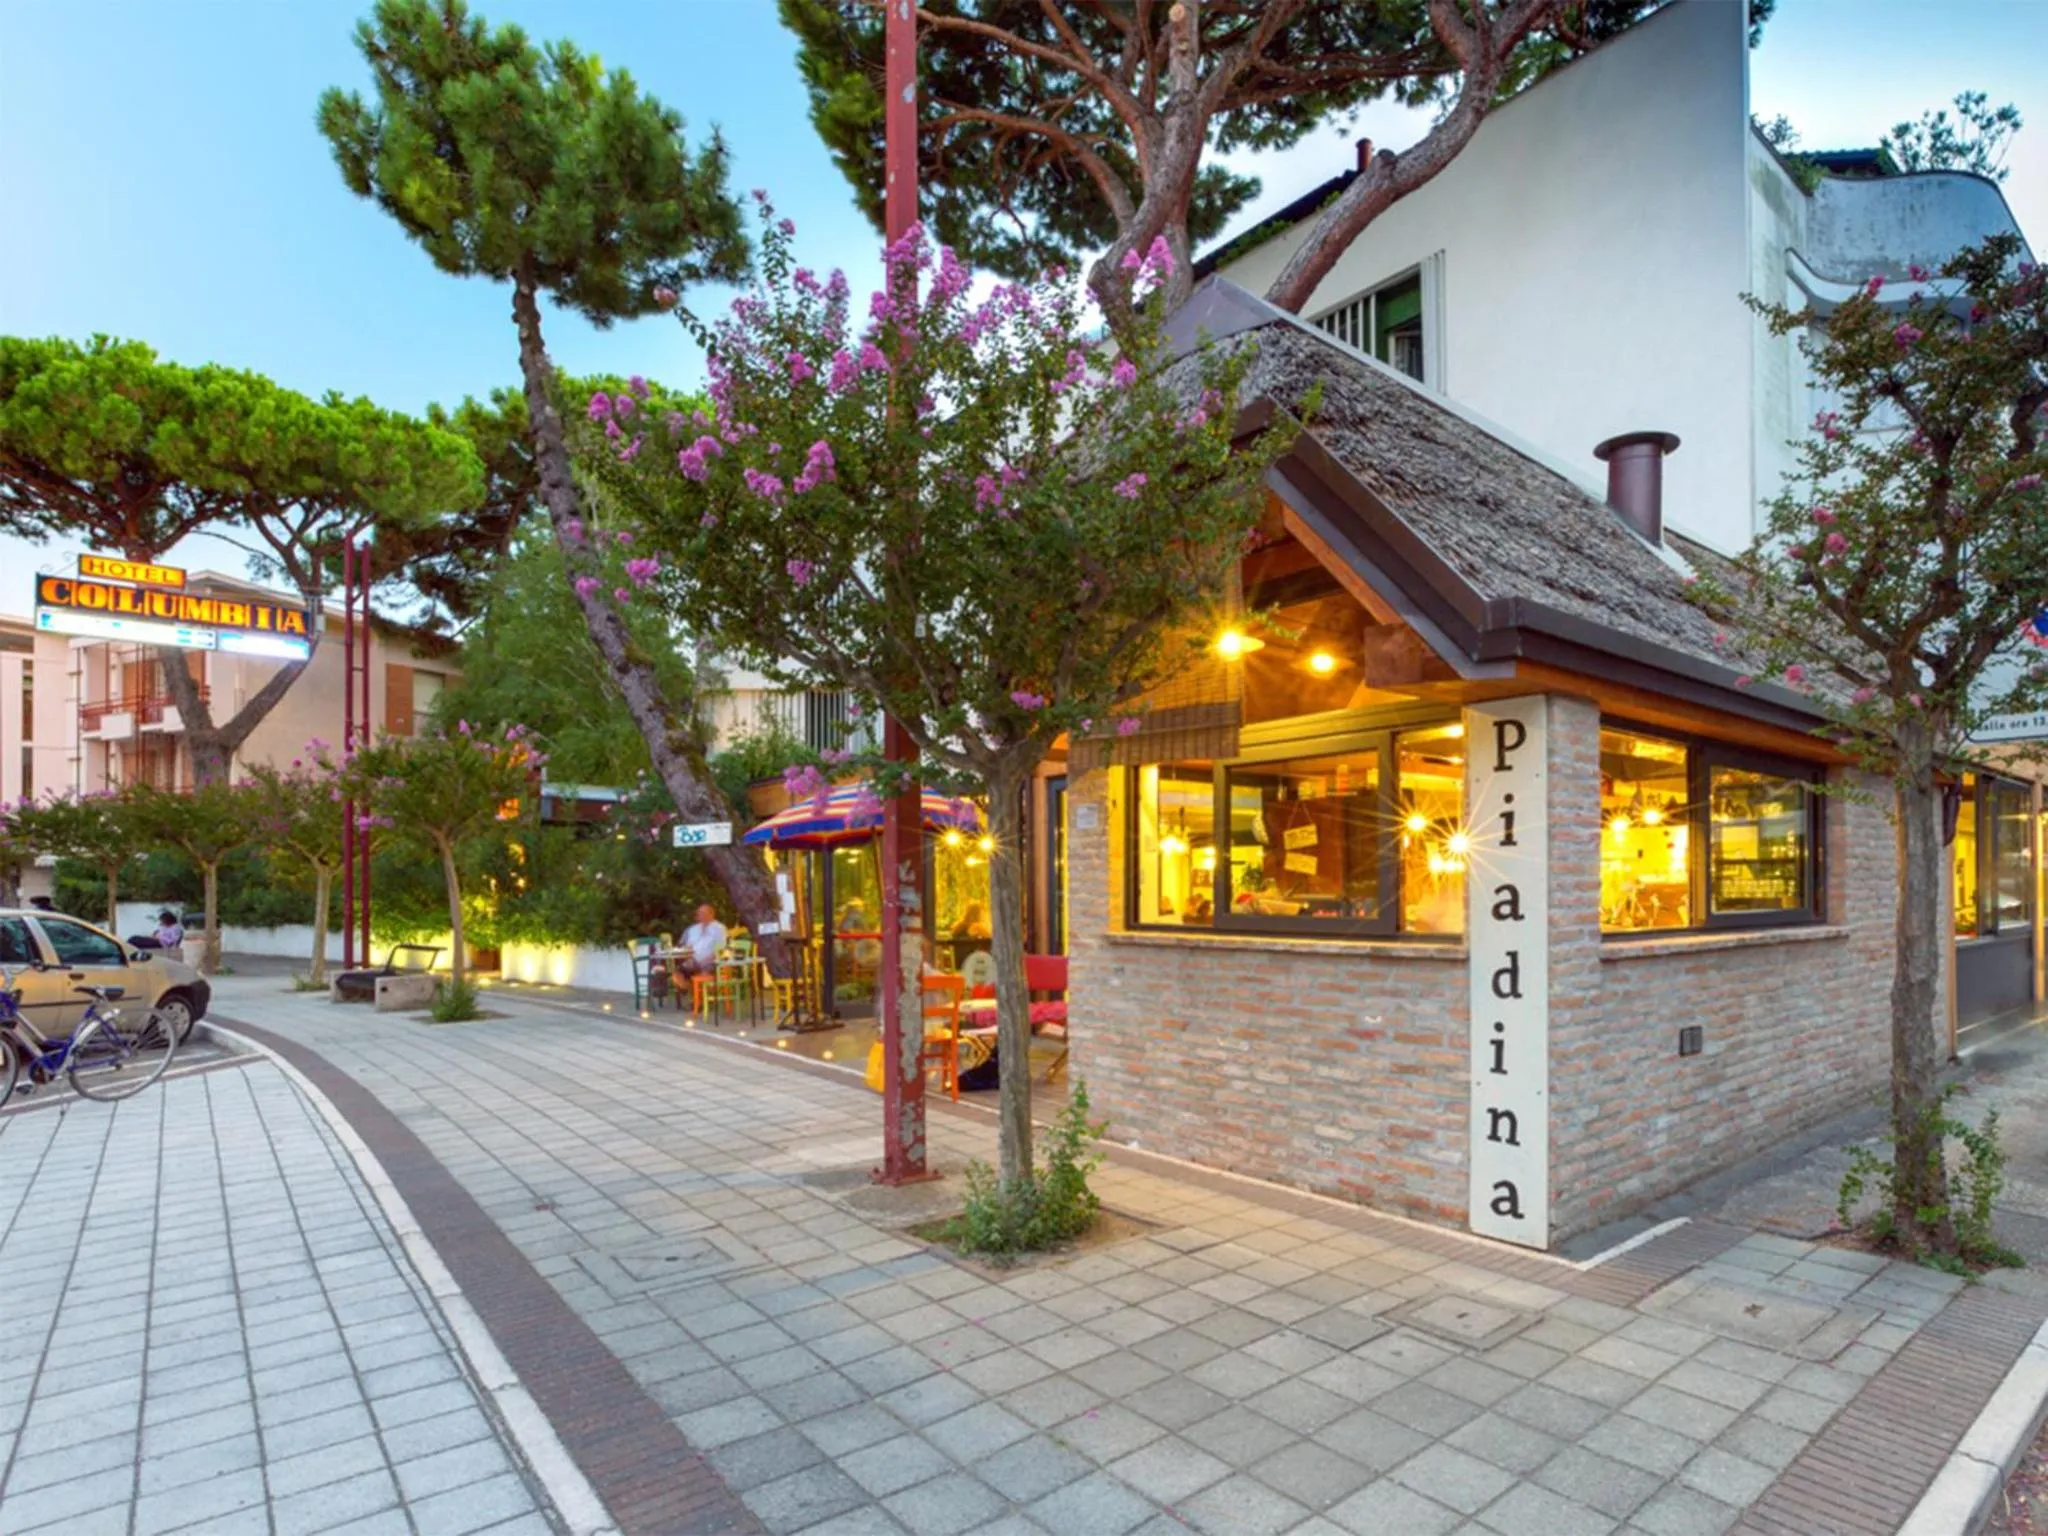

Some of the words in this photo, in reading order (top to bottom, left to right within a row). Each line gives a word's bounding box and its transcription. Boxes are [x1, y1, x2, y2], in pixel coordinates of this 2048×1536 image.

[88, 558, 175, 582] HOTEL
[41, 579, 307, 635] COLUMBIA
[1486, 718, 1528, 1220] Piadina
